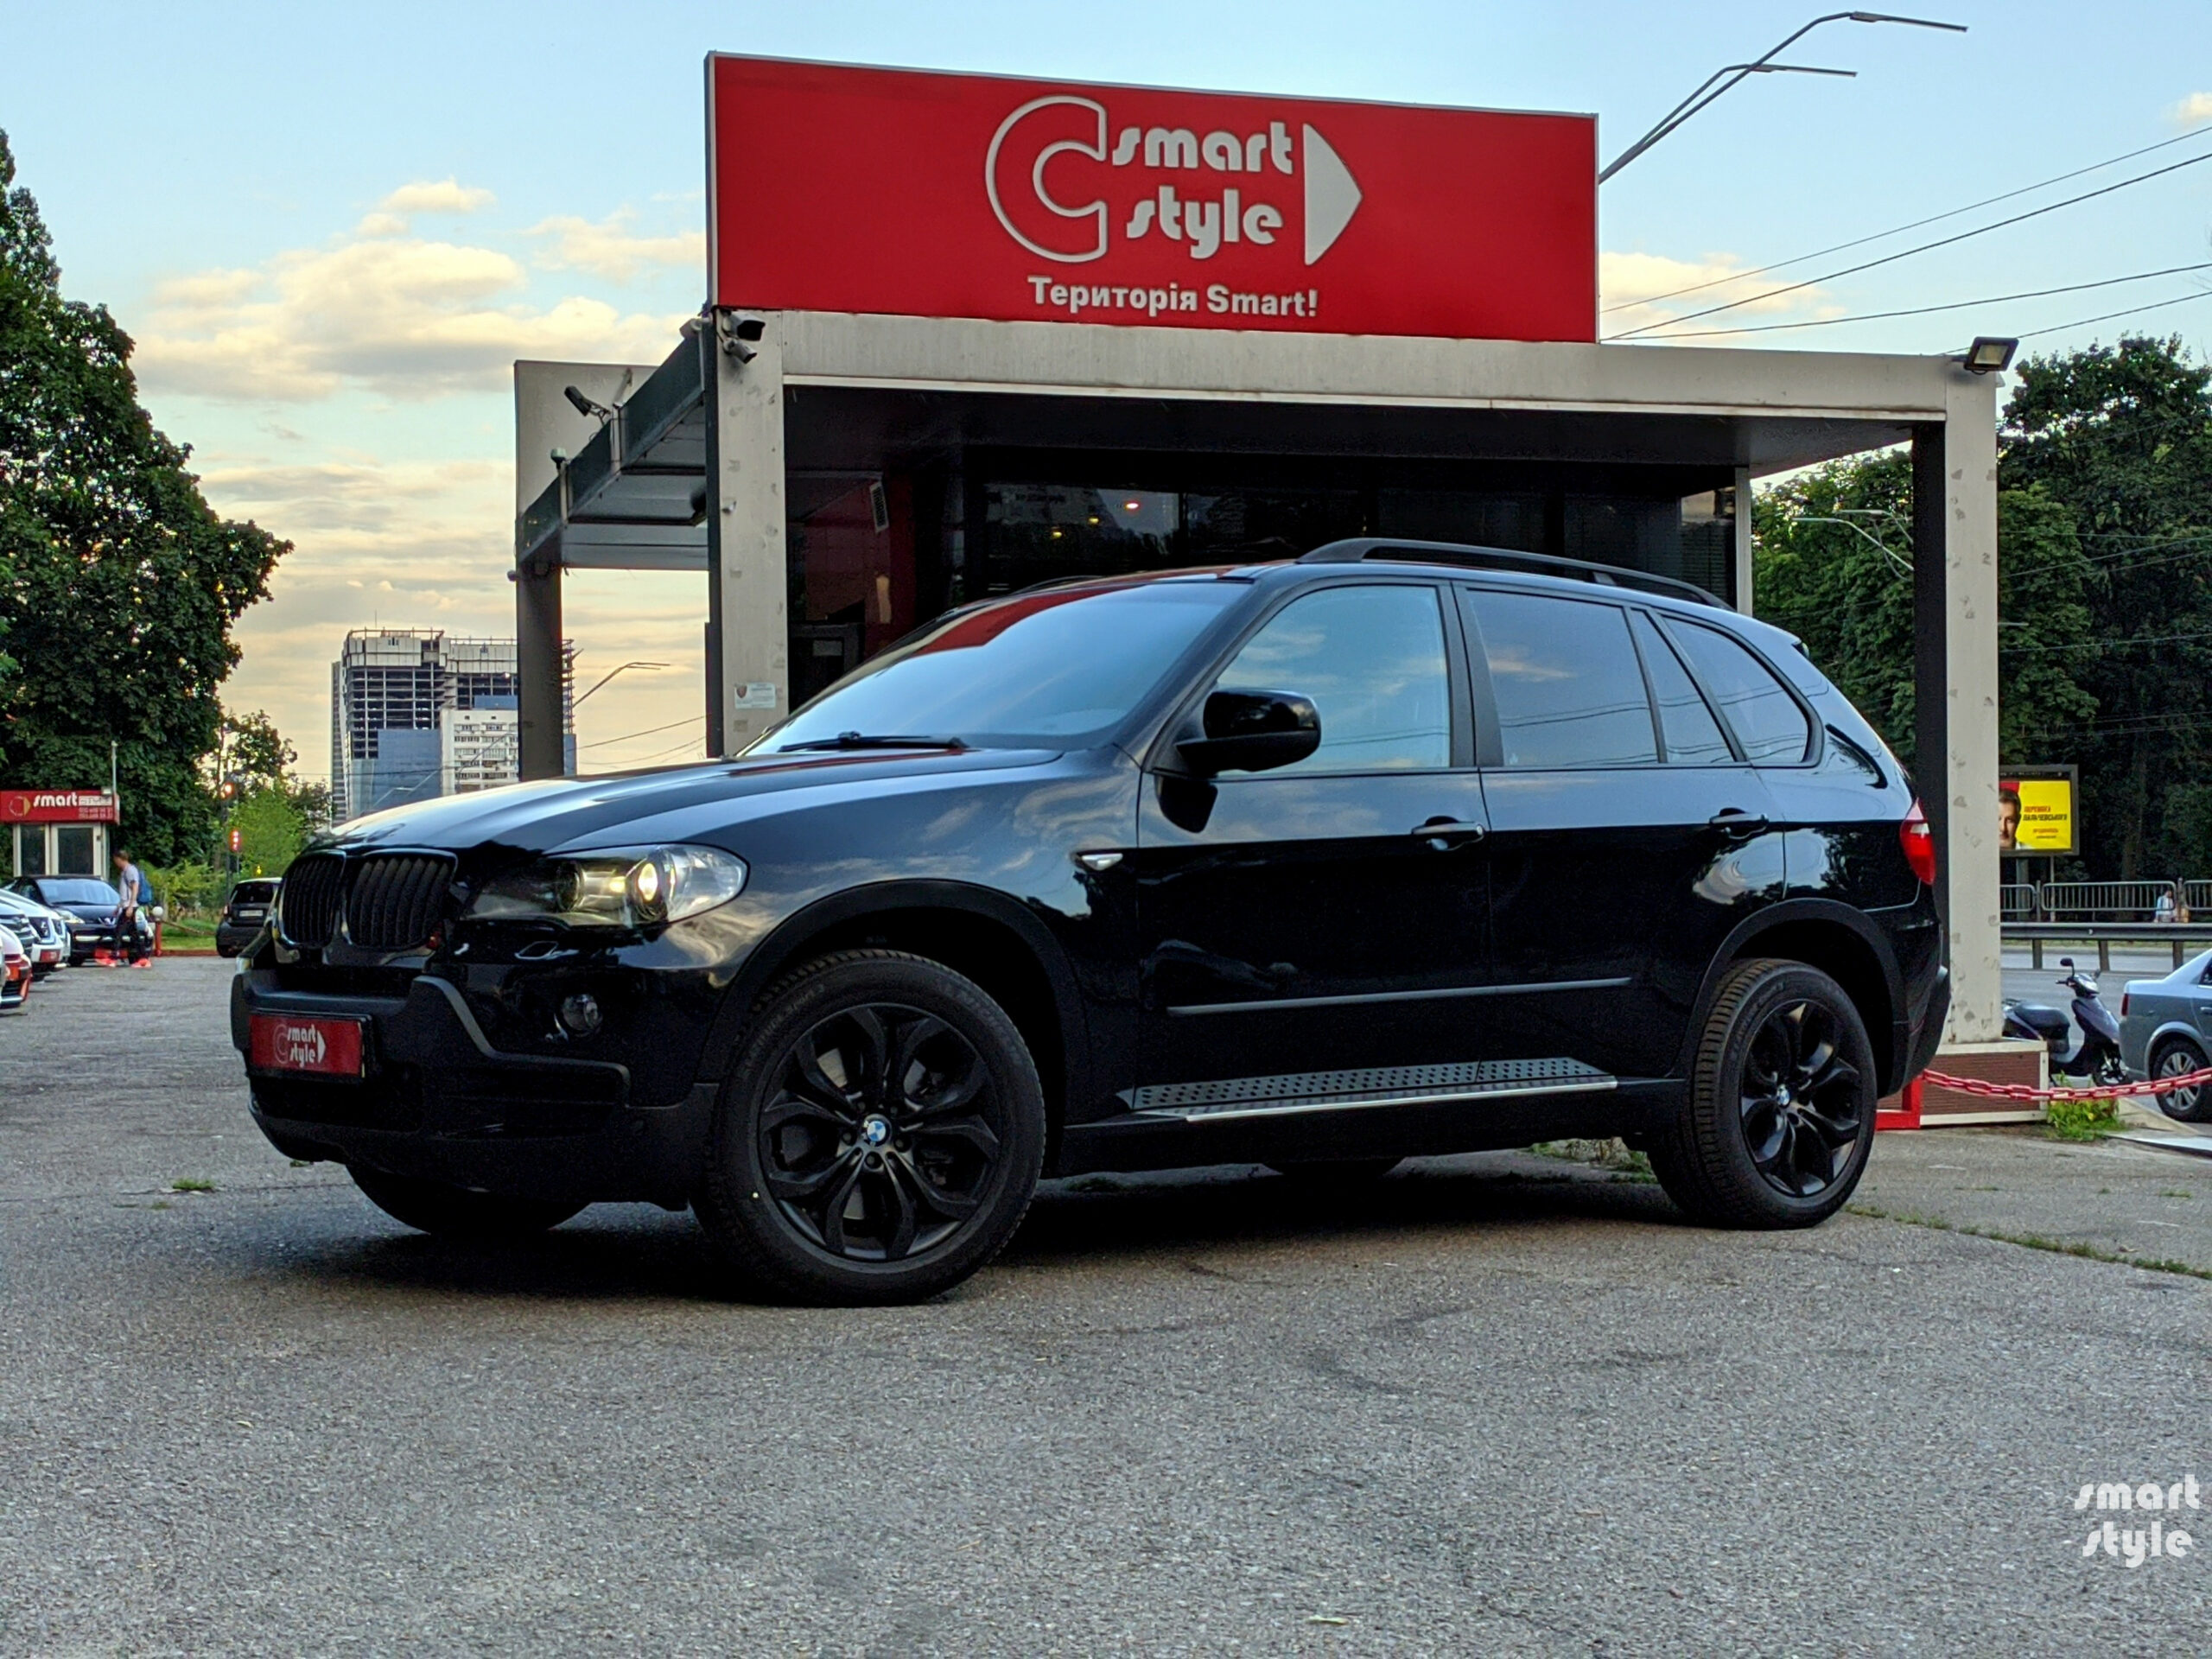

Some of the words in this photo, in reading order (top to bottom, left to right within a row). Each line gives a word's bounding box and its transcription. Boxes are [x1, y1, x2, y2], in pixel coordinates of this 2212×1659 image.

[1112, 121, 1294, 175] smart
[1126, 184, 1283, 259] style
[1027, 276, 1198, 317] Територія
[1206, 284, 1319, 317] Smart!
[33, 791, 79, 807] smart
[287, 1023, 316, 1043] smart
[289, 1042, 316, 1069] style
